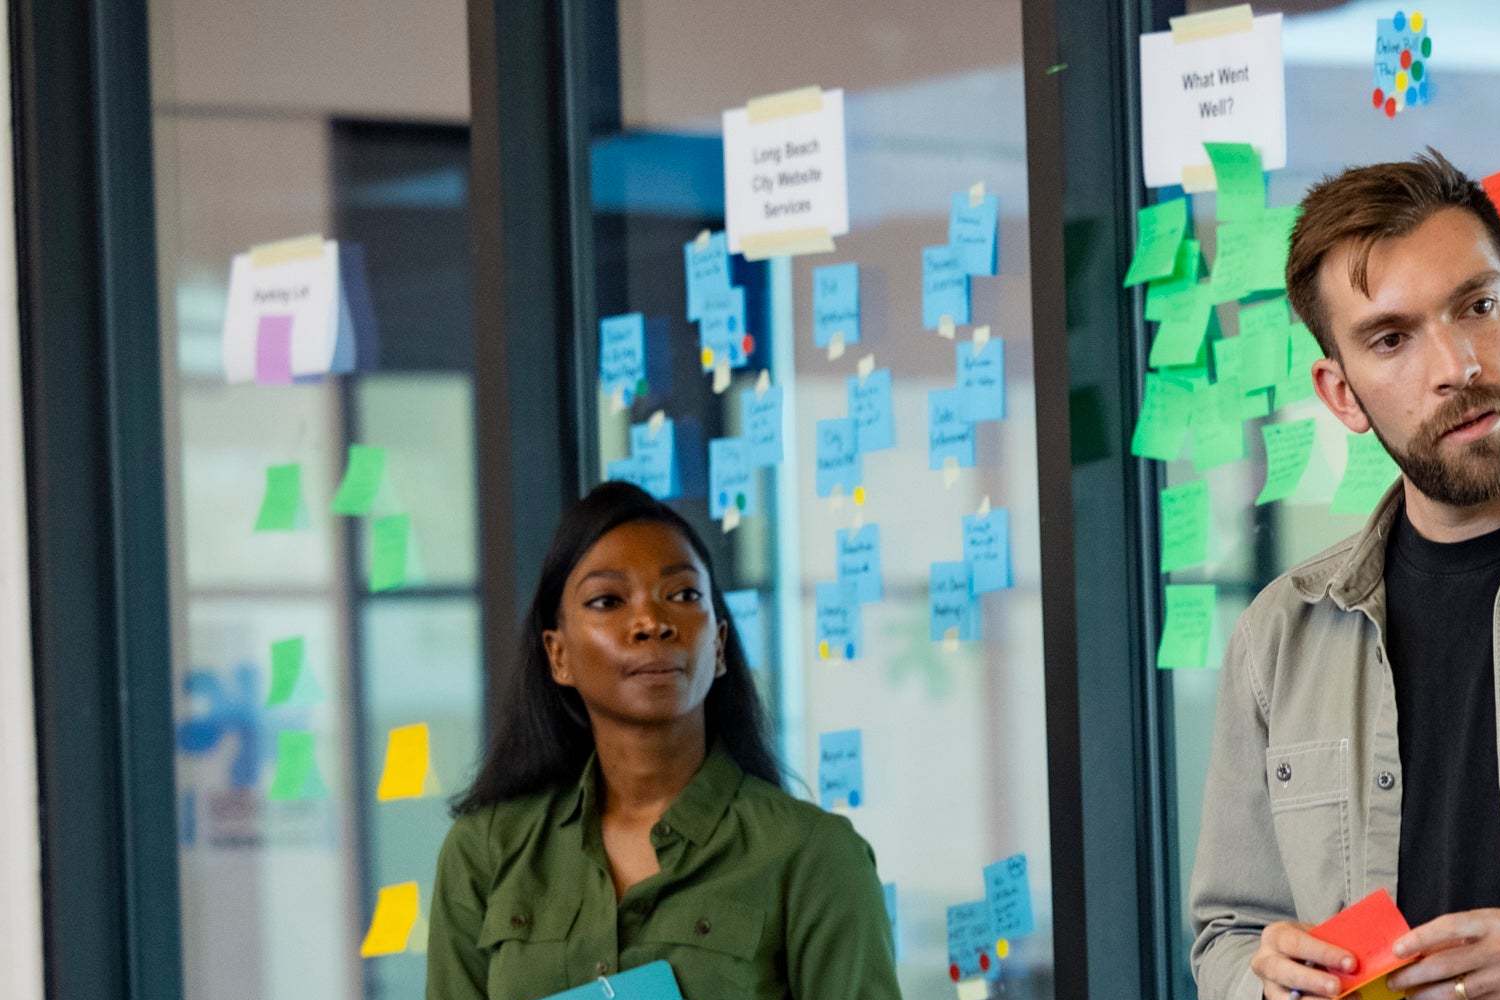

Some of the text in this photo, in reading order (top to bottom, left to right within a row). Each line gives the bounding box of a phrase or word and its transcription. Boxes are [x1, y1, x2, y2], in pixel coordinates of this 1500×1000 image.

[1182, 65, 1250, 91] What Went
[1199, 98, 1234, 119] Well?
[752, 140, 820, 165] Long Beach
[752, 168, 822, 195] City Website
[764, 200, 812, 219] Services
